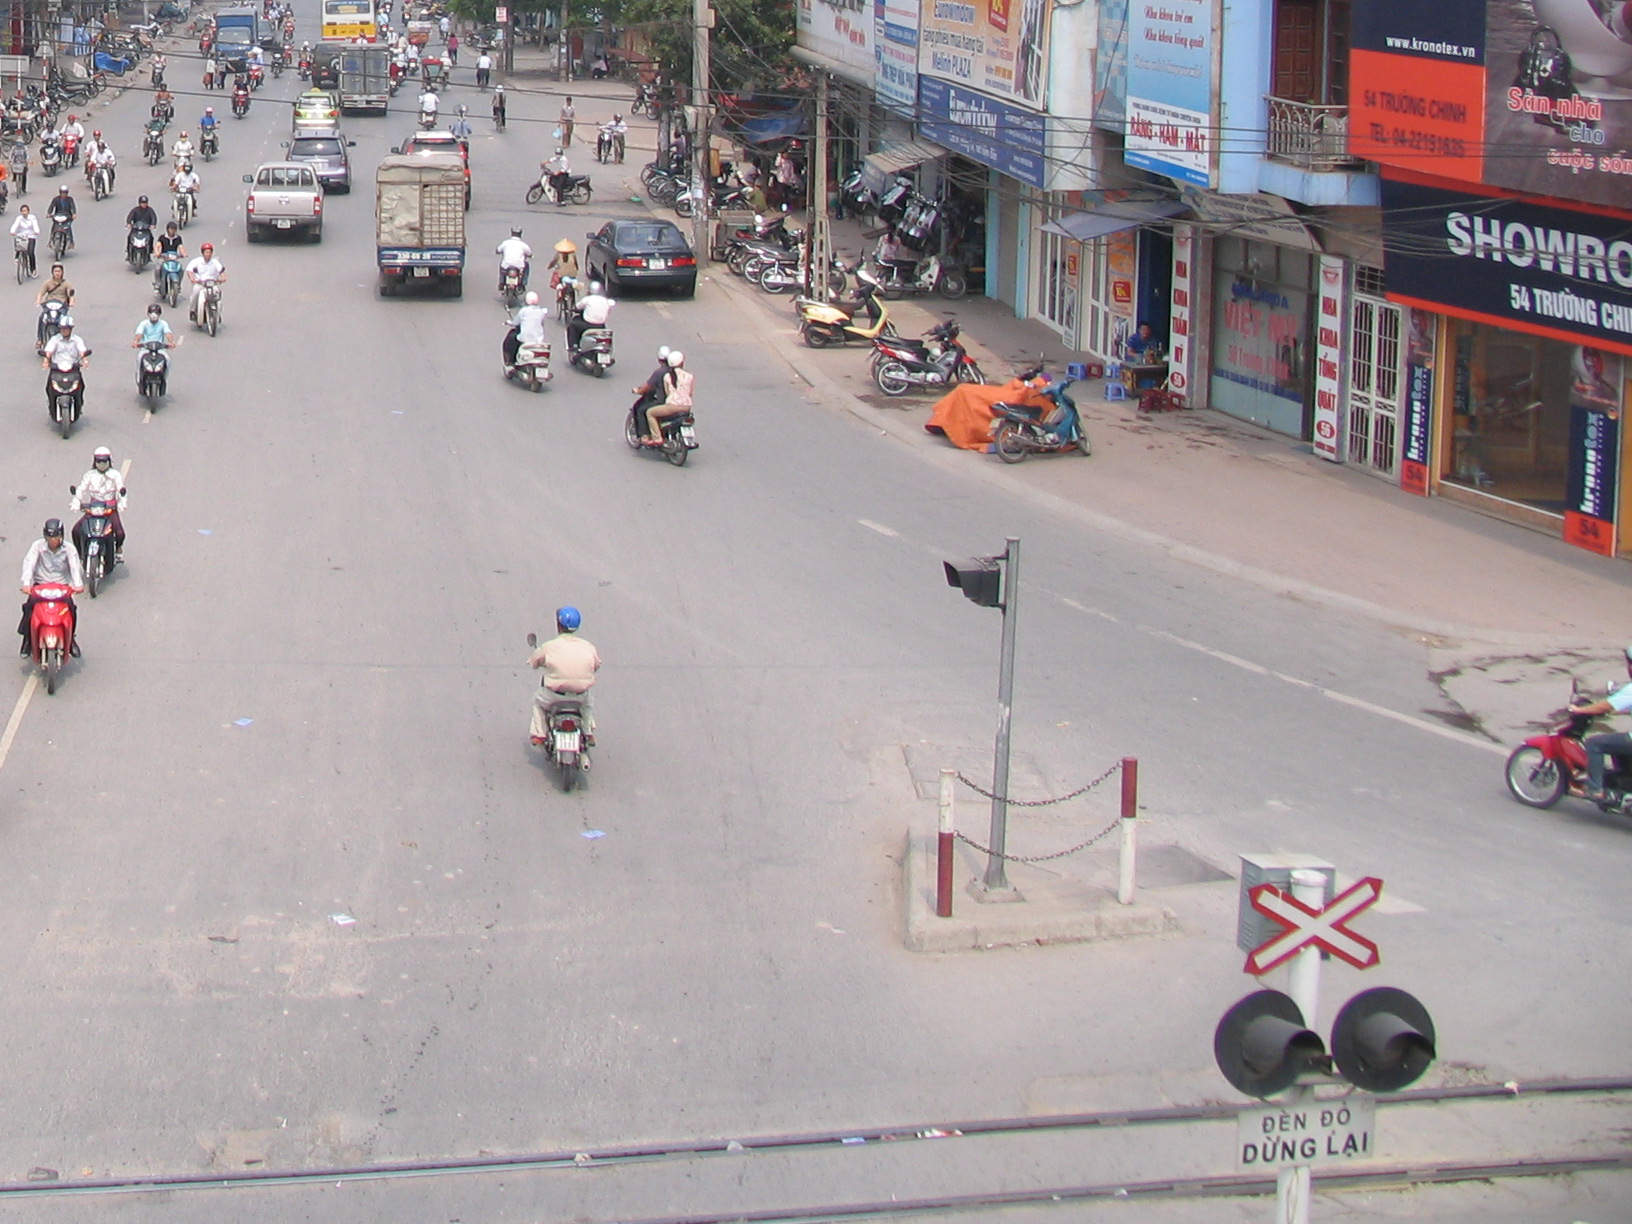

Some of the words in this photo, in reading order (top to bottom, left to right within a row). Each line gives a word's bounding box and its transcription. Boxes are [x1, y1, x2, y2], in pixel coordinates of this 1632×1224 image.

[1386, 35, 1476, 58] www.kronotex.vn
[1570, 124, 1605, 146] cho
[1599, 150, 1632, 175] sốn
[1509, 283, 1529, 312] 54
[1532, 287, 1598, 326] TRƯỜNG
[1580, 411, 1598, 515] kronotex
[1262, 1109, 1306, 1135] ĐÈN
[1320, 1101, 1352, 1127] ĐỎ
[1241, 1129, 1317, 1164] DỪNG
[1327, 1131, 1368, 1159] LẠI
